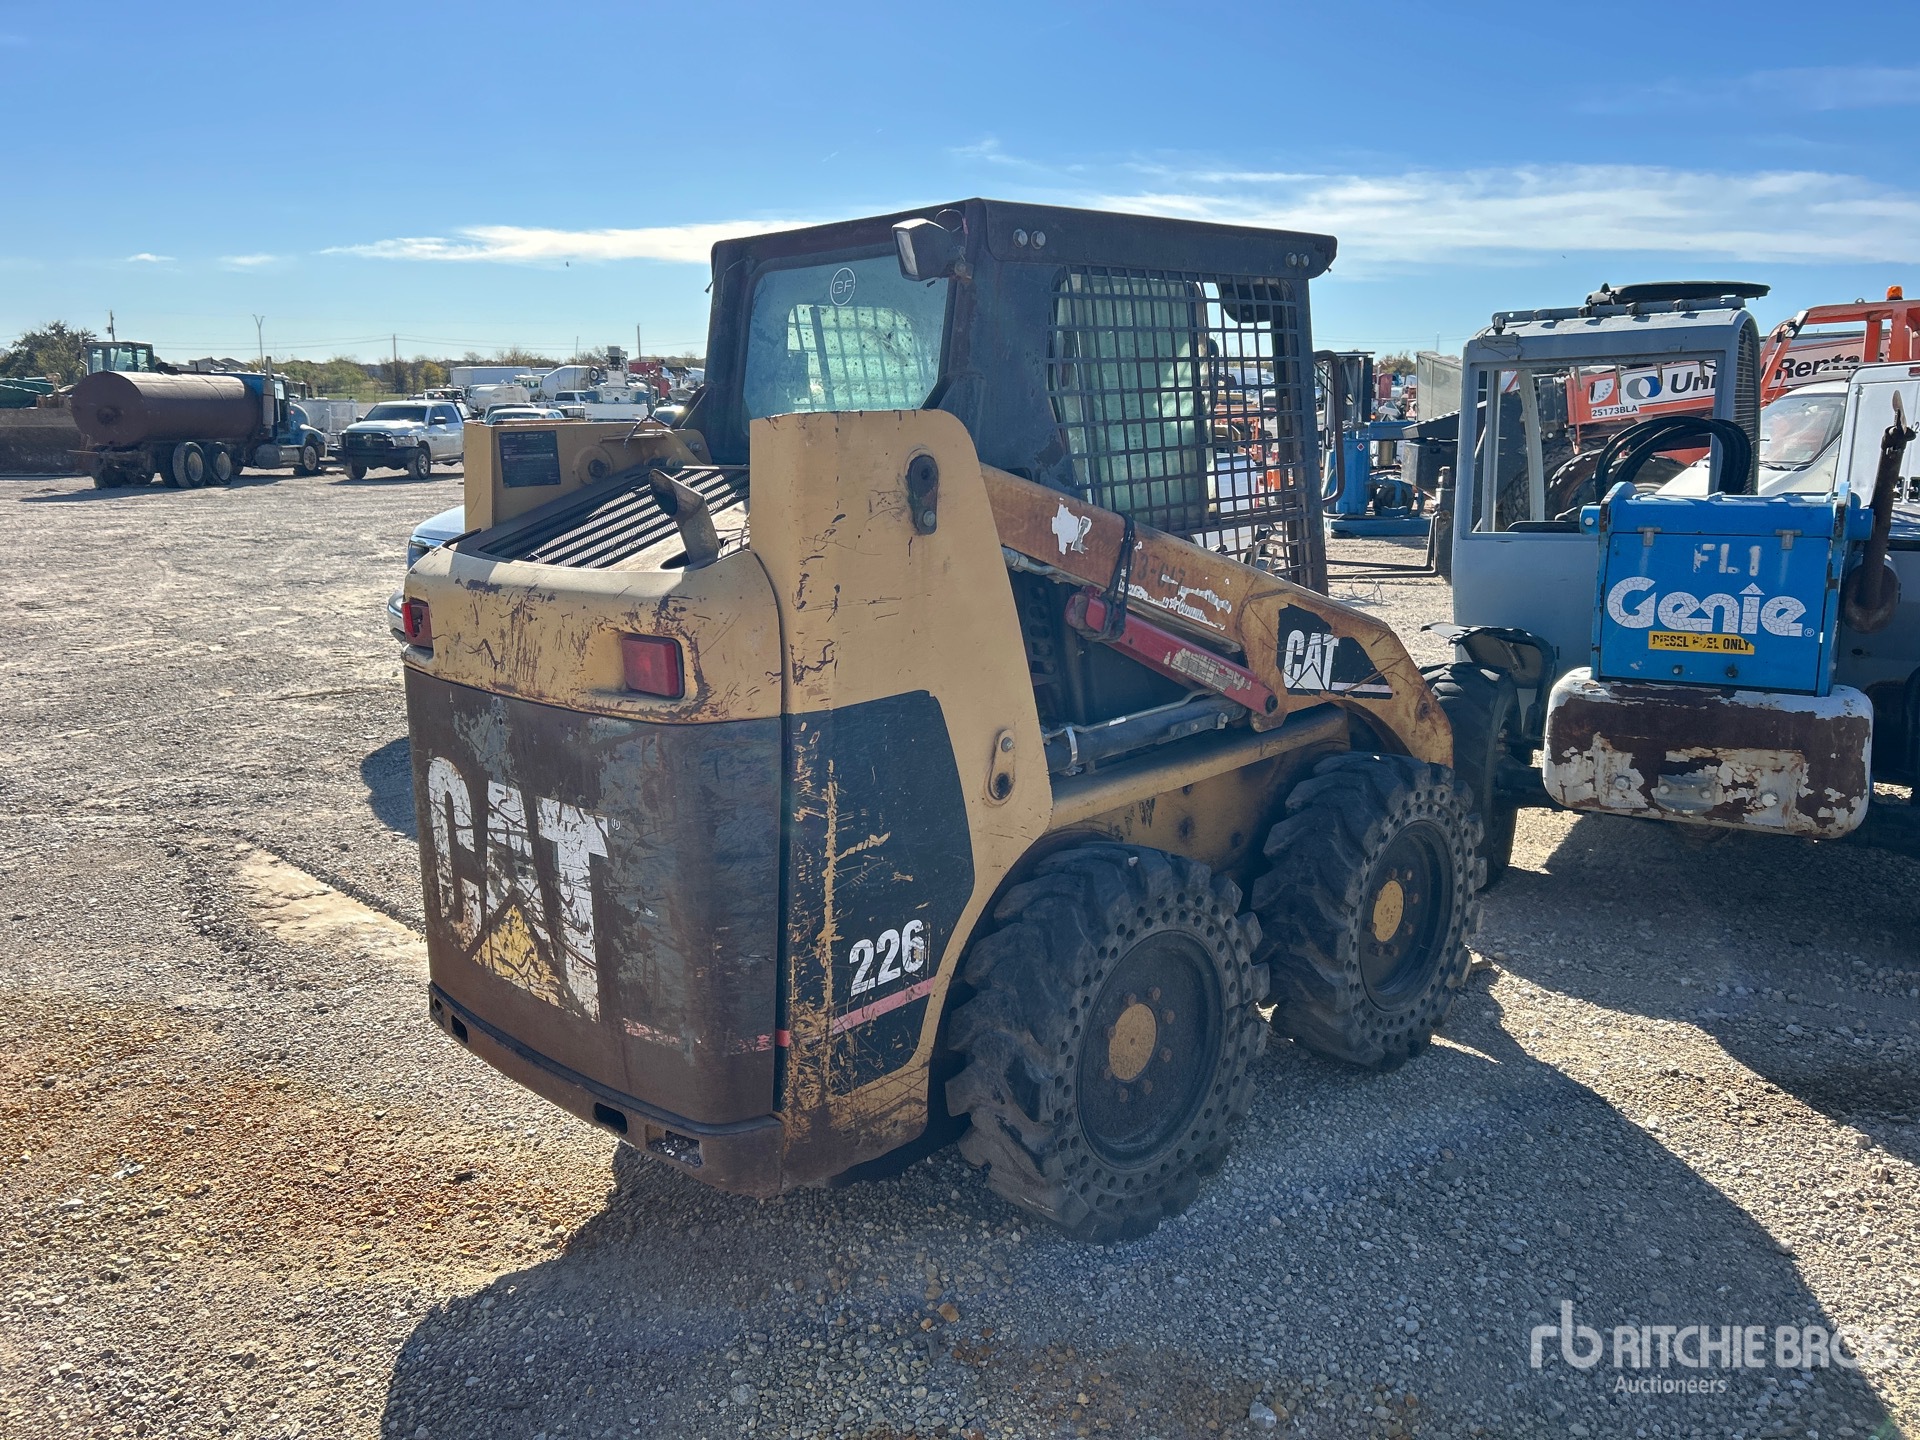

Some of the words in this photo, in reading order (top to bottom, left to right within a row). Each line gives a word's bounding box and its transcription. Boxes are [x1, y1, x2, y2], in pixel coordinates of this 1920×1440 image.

[1591, 405, 1639, 418] 25173BLA
[1607, 576, 1807, 637] Genie
[1282, 628, 1340, 691] CAT
[1722, 637, 1751, 651] ONLY
[428, 756, 608, 1022] CAT
[848, 919, 925, 997] 226
